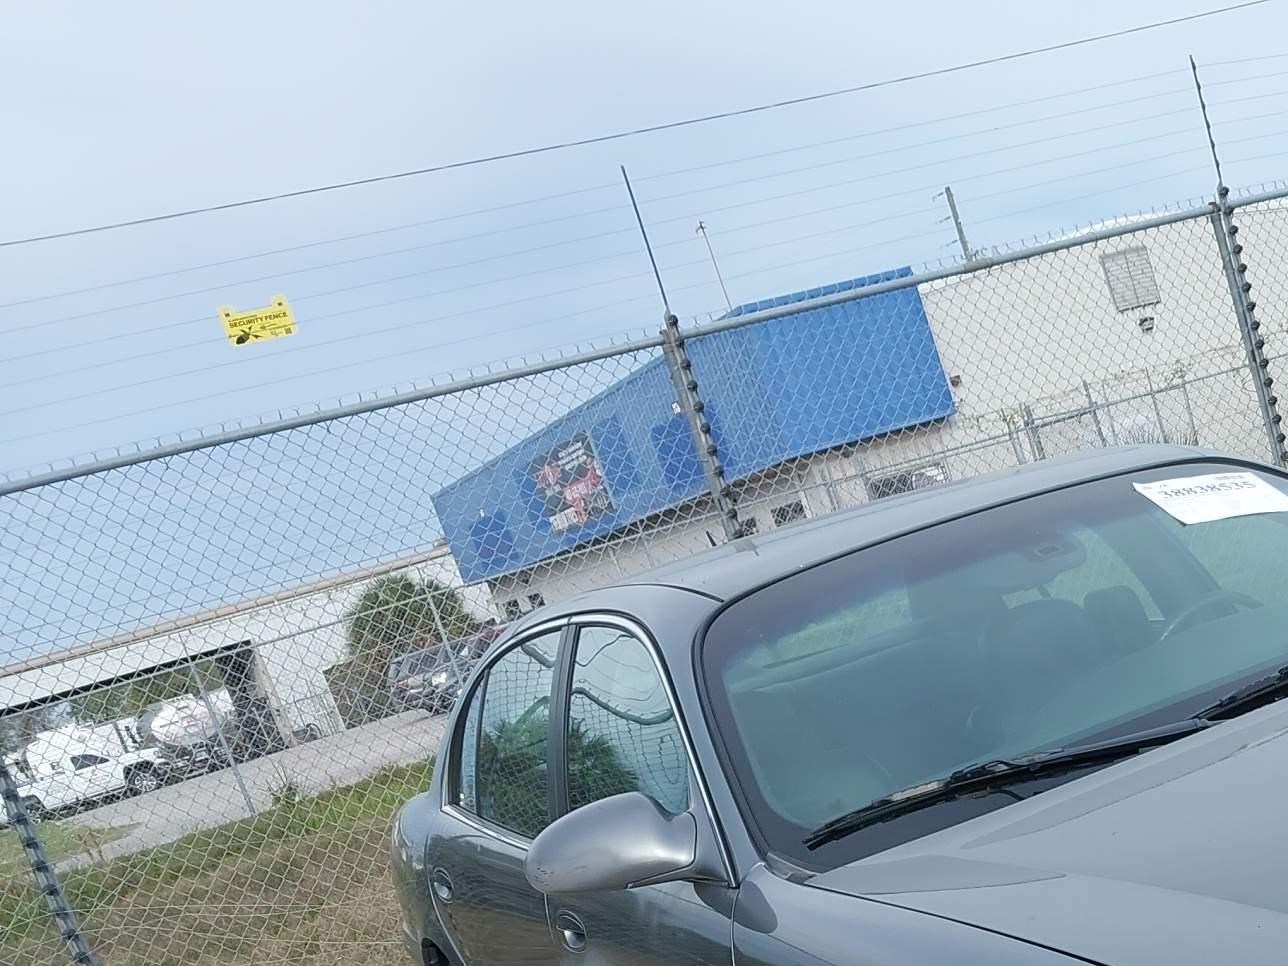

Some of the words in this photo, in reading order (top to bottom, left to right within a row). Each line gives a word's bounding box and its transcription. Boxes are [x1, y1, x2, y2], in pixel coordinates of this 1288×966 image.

[229, 316, 264, 329] SECURITY
[264, 311, 289, 321] FENCE
[1158, 479, 1258, 500] 38838535
